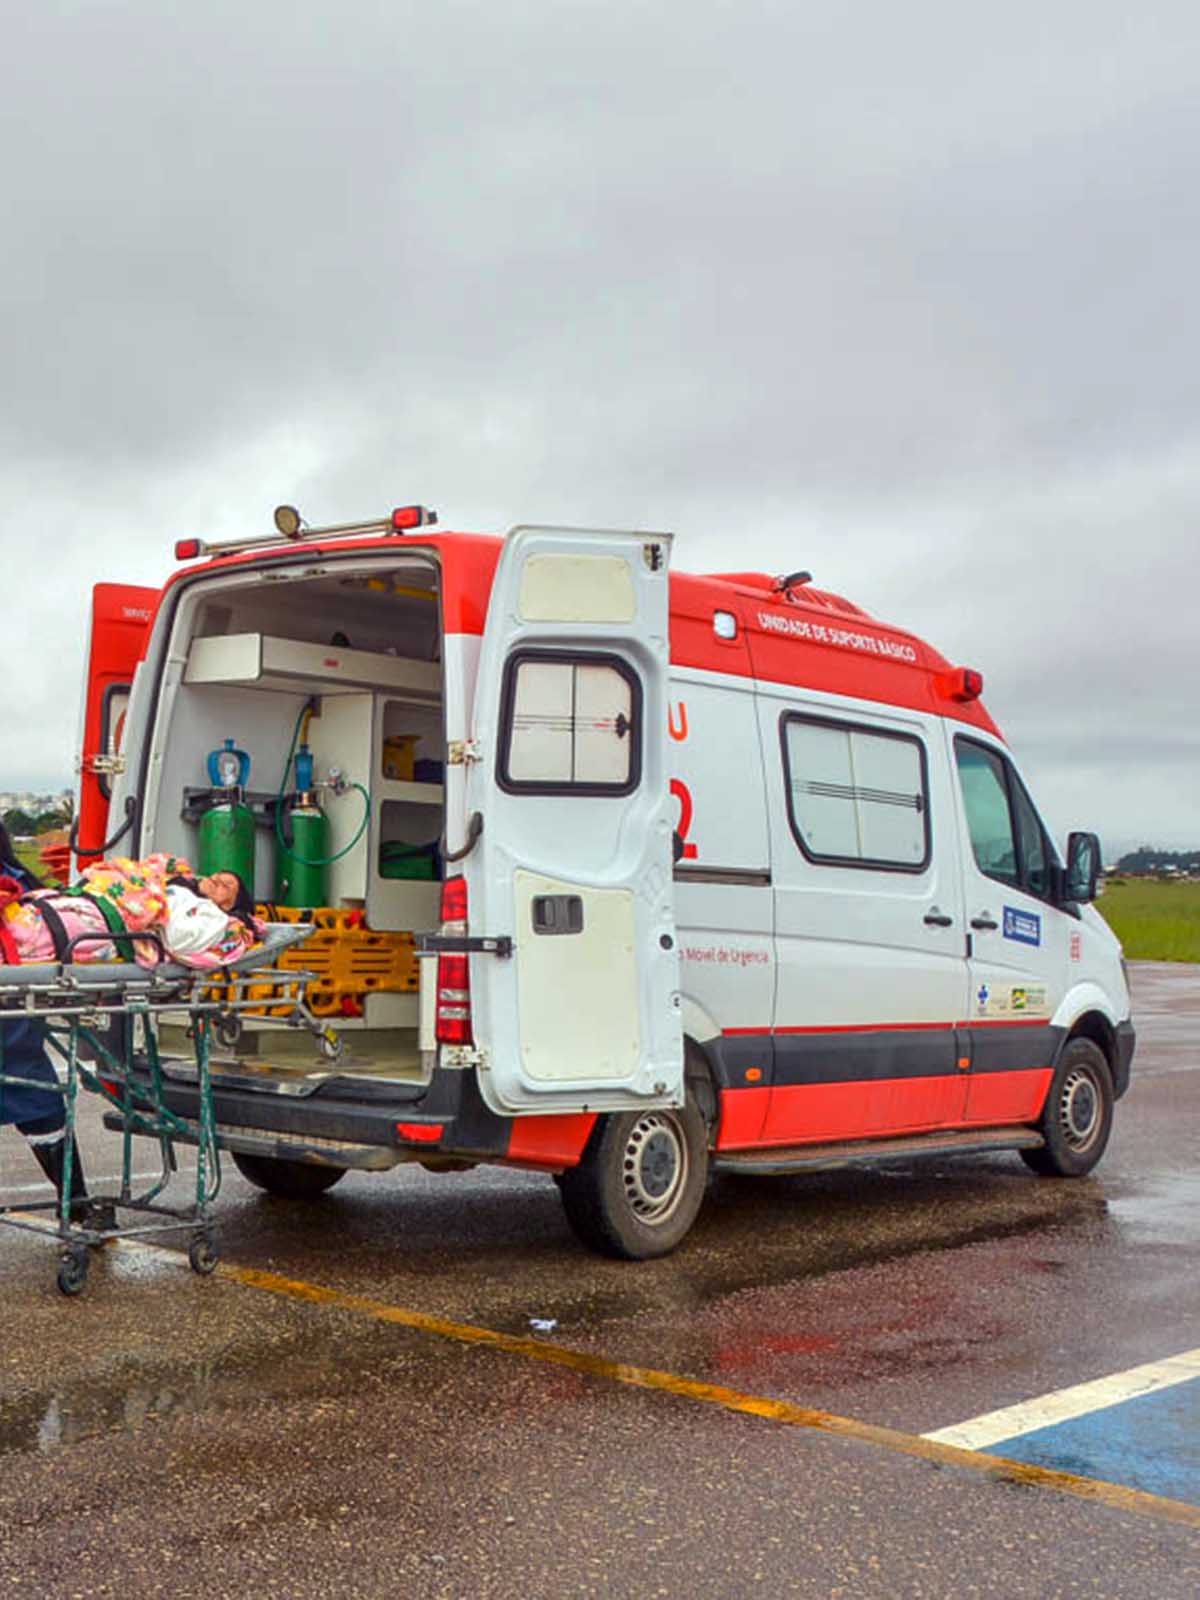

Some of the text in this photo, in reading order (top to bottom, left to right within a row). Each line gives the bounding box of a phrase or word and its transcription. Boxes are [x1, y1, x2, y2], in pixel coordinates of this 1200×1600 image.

[757, 612, 812, 637] UNIDADE
[812, 624, 828, 642] DE
[829, 628, 877, 653] SUPORTE
[718, 945, 728, 961] de
